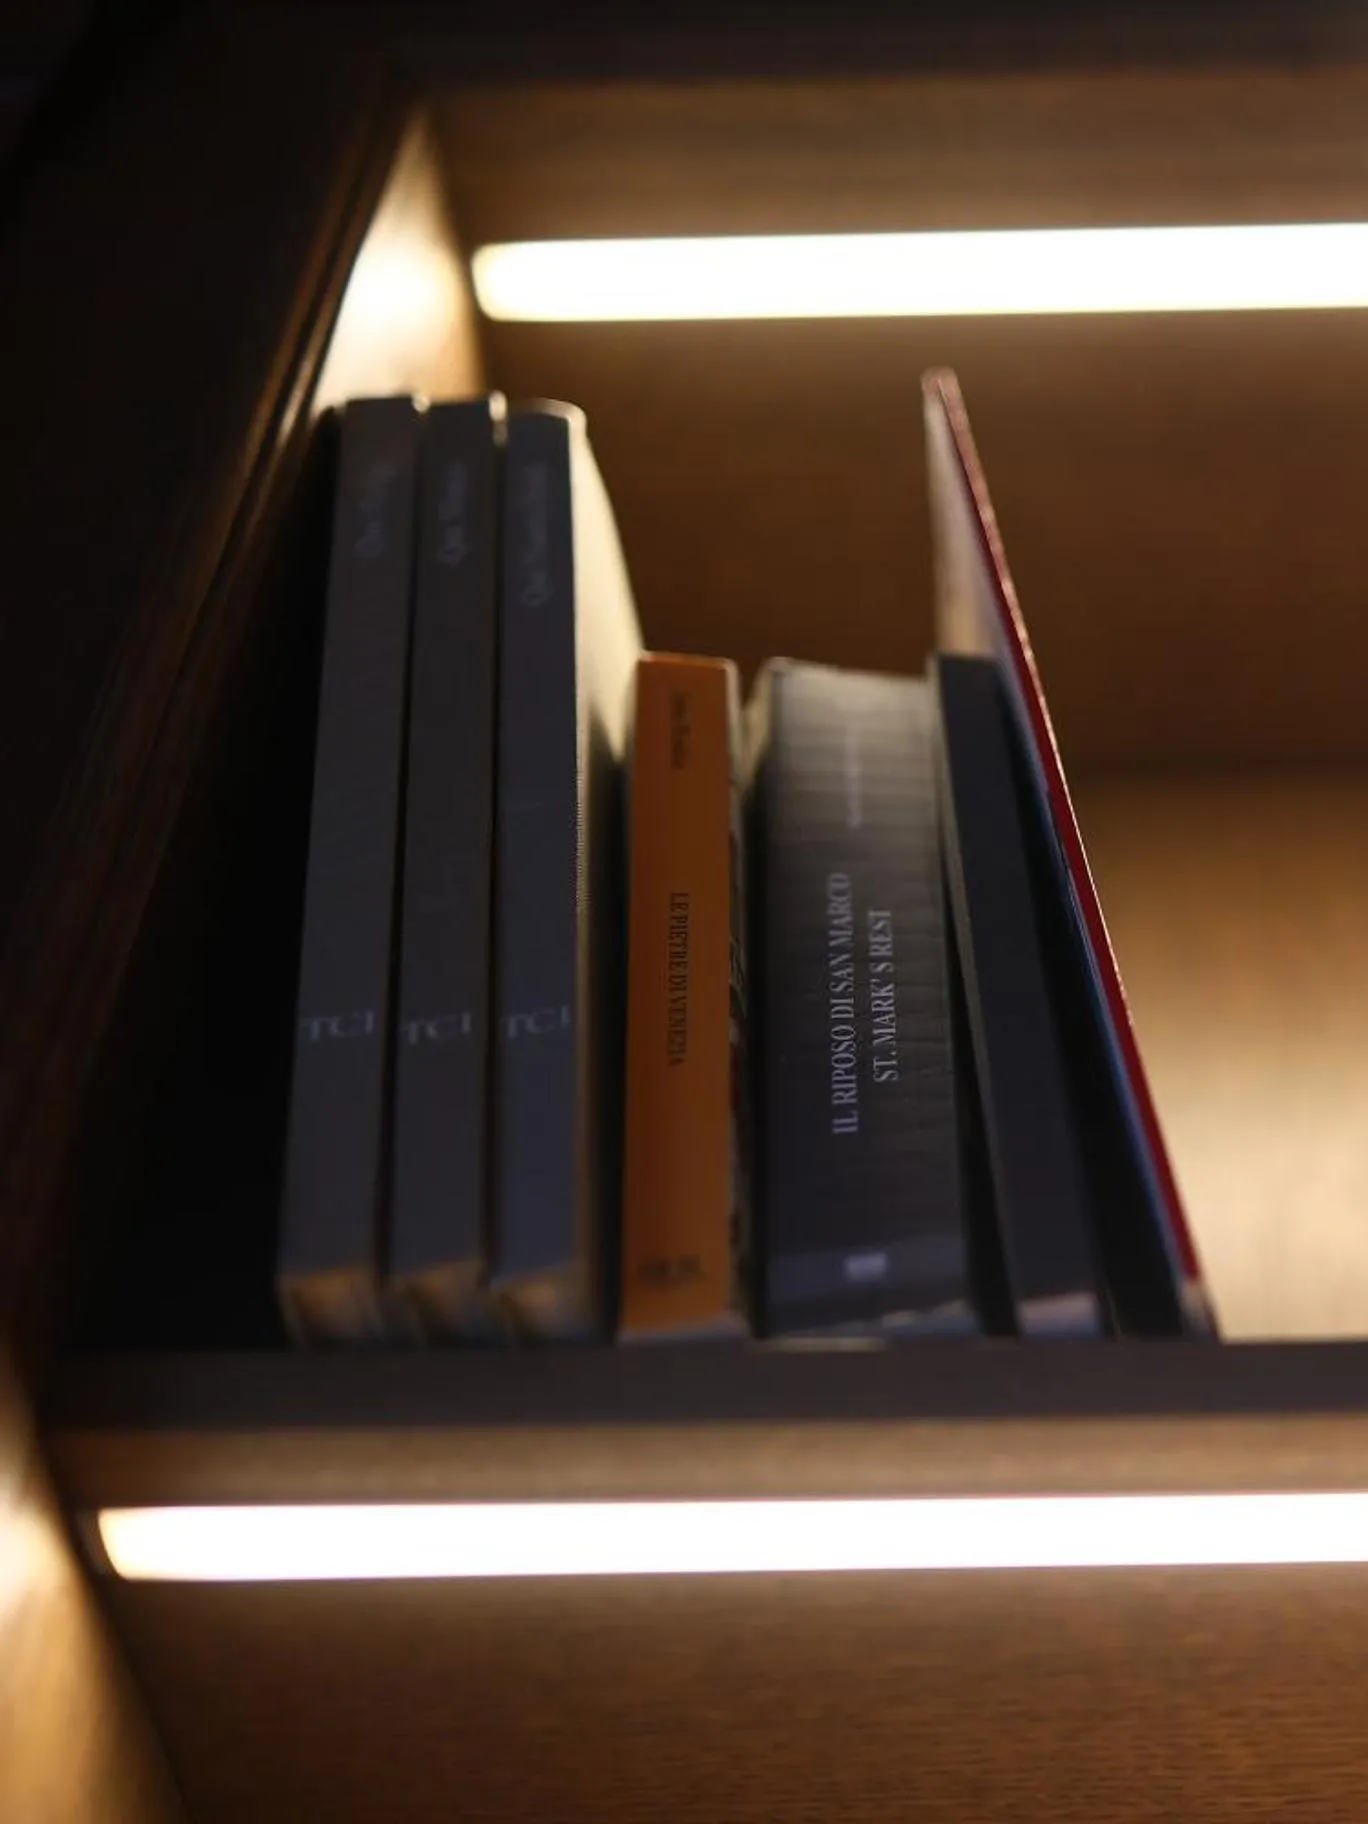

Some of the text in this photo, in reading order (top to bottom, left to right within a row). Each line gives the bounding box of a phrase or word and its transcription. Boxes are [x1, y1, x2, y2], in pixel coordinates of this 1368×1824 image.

[868, 908, 893, 956] REST
[827, 872, 858, 1135] IL RIPOSO DI SAN MARCO
[872, 1050, 898, 1084] ST.
